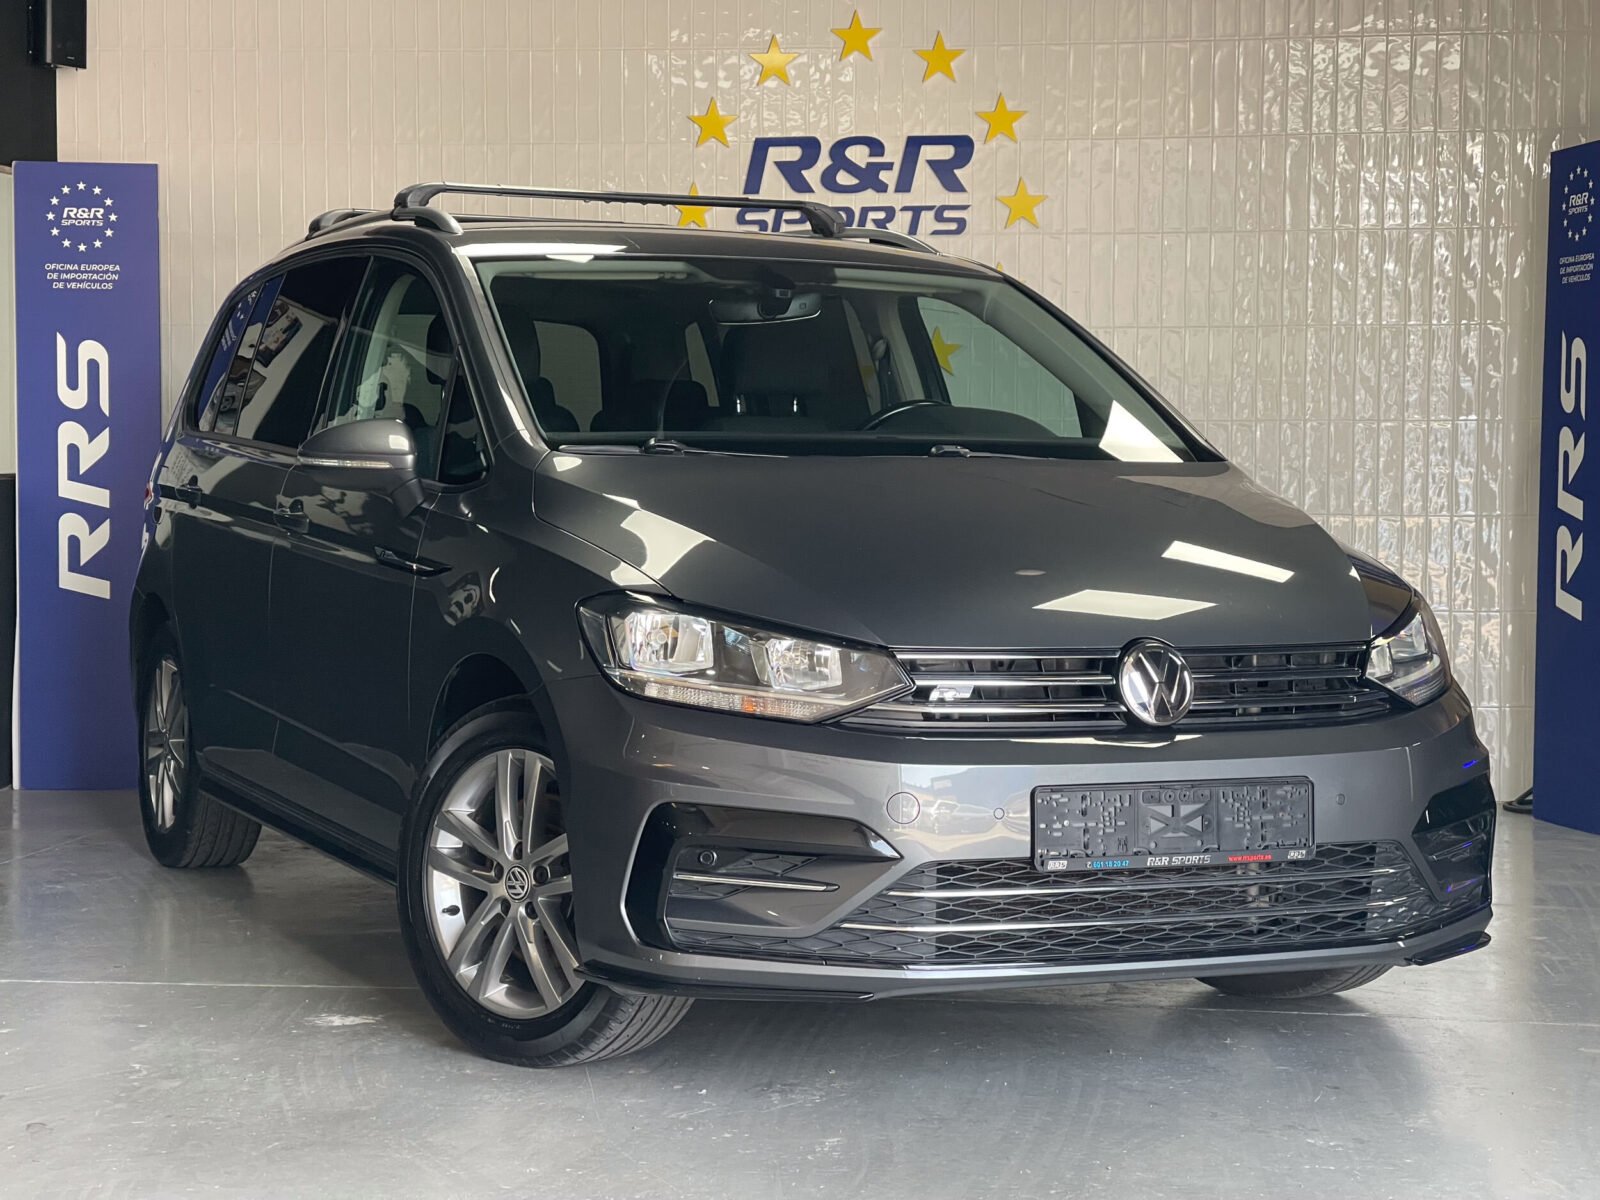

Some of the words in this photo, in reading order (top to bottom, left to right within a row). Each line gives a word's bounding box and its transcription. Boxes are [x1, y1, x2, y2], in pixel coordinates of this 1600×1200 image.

[743, 135, 975, 195] R&R
[1568, 192, 1589, 207] R&R
[63, 207, 104, 218] R&R
[1568, 204, 1588, 216] SPORTS
[45, 263, 78, 271] OFICINA
[60, 272, 119, 280] IMPORTACIÓN
[66, 281, 113, 289] VEHÍCULOS
[56, 331, 111, 600] RRS
[1555, 329, 1587, 621] RRS
[1147, 856, 1170, 867] R&R
[1171, 854, 1211, 866] SPORTS
